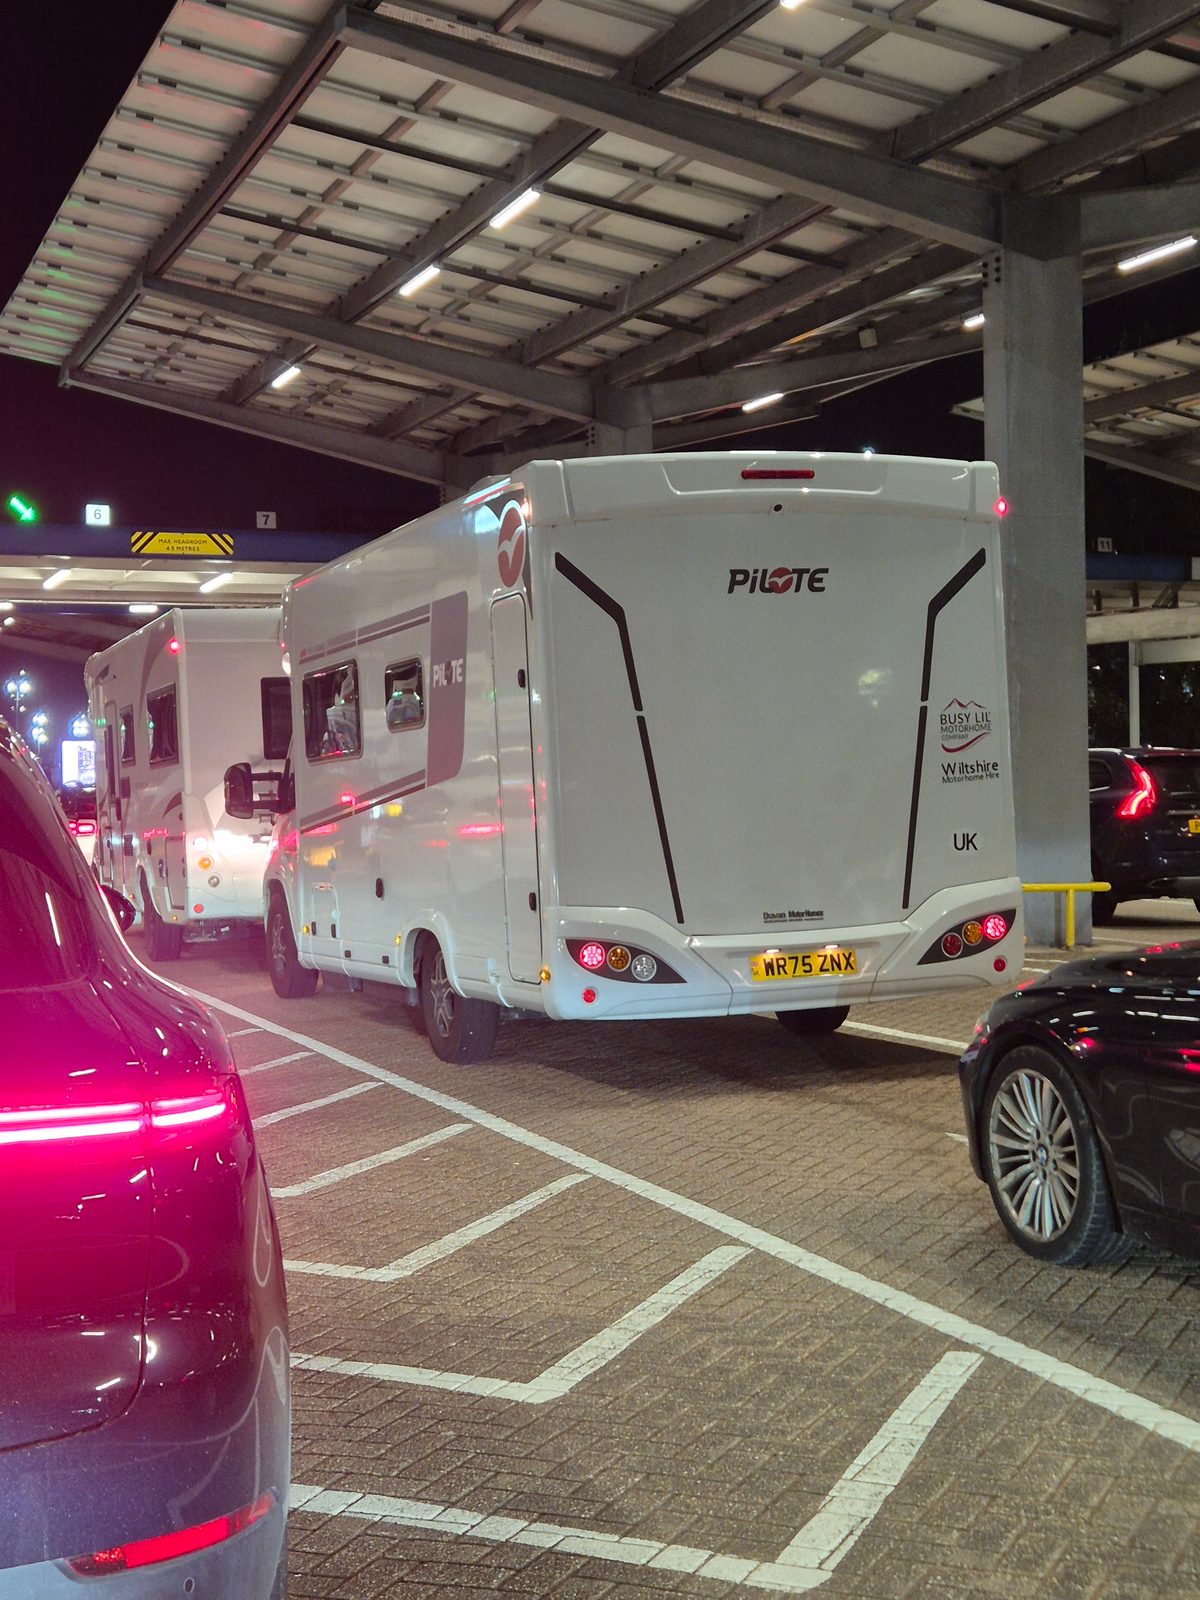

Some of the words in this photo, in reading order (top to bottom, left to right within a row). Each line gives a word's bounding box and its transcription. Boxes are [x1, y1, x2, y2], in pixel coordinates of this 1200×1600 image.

[94, 508, 101, 520] 6
[262, 514, 269, 525] 7
[940, 713, 971, 726] BUSY
[940, 723, 992, 733] MOTORHOME
[941, 760, 999, 776] Wiltshire
[942, 773, 984, 784] Motorhome
[985, 771, 1000, 780] Hire
[953, 832, 978, 851] UK
[763, 954, 813, 976] WR75
[817, 952, 854, 972] ZNX
